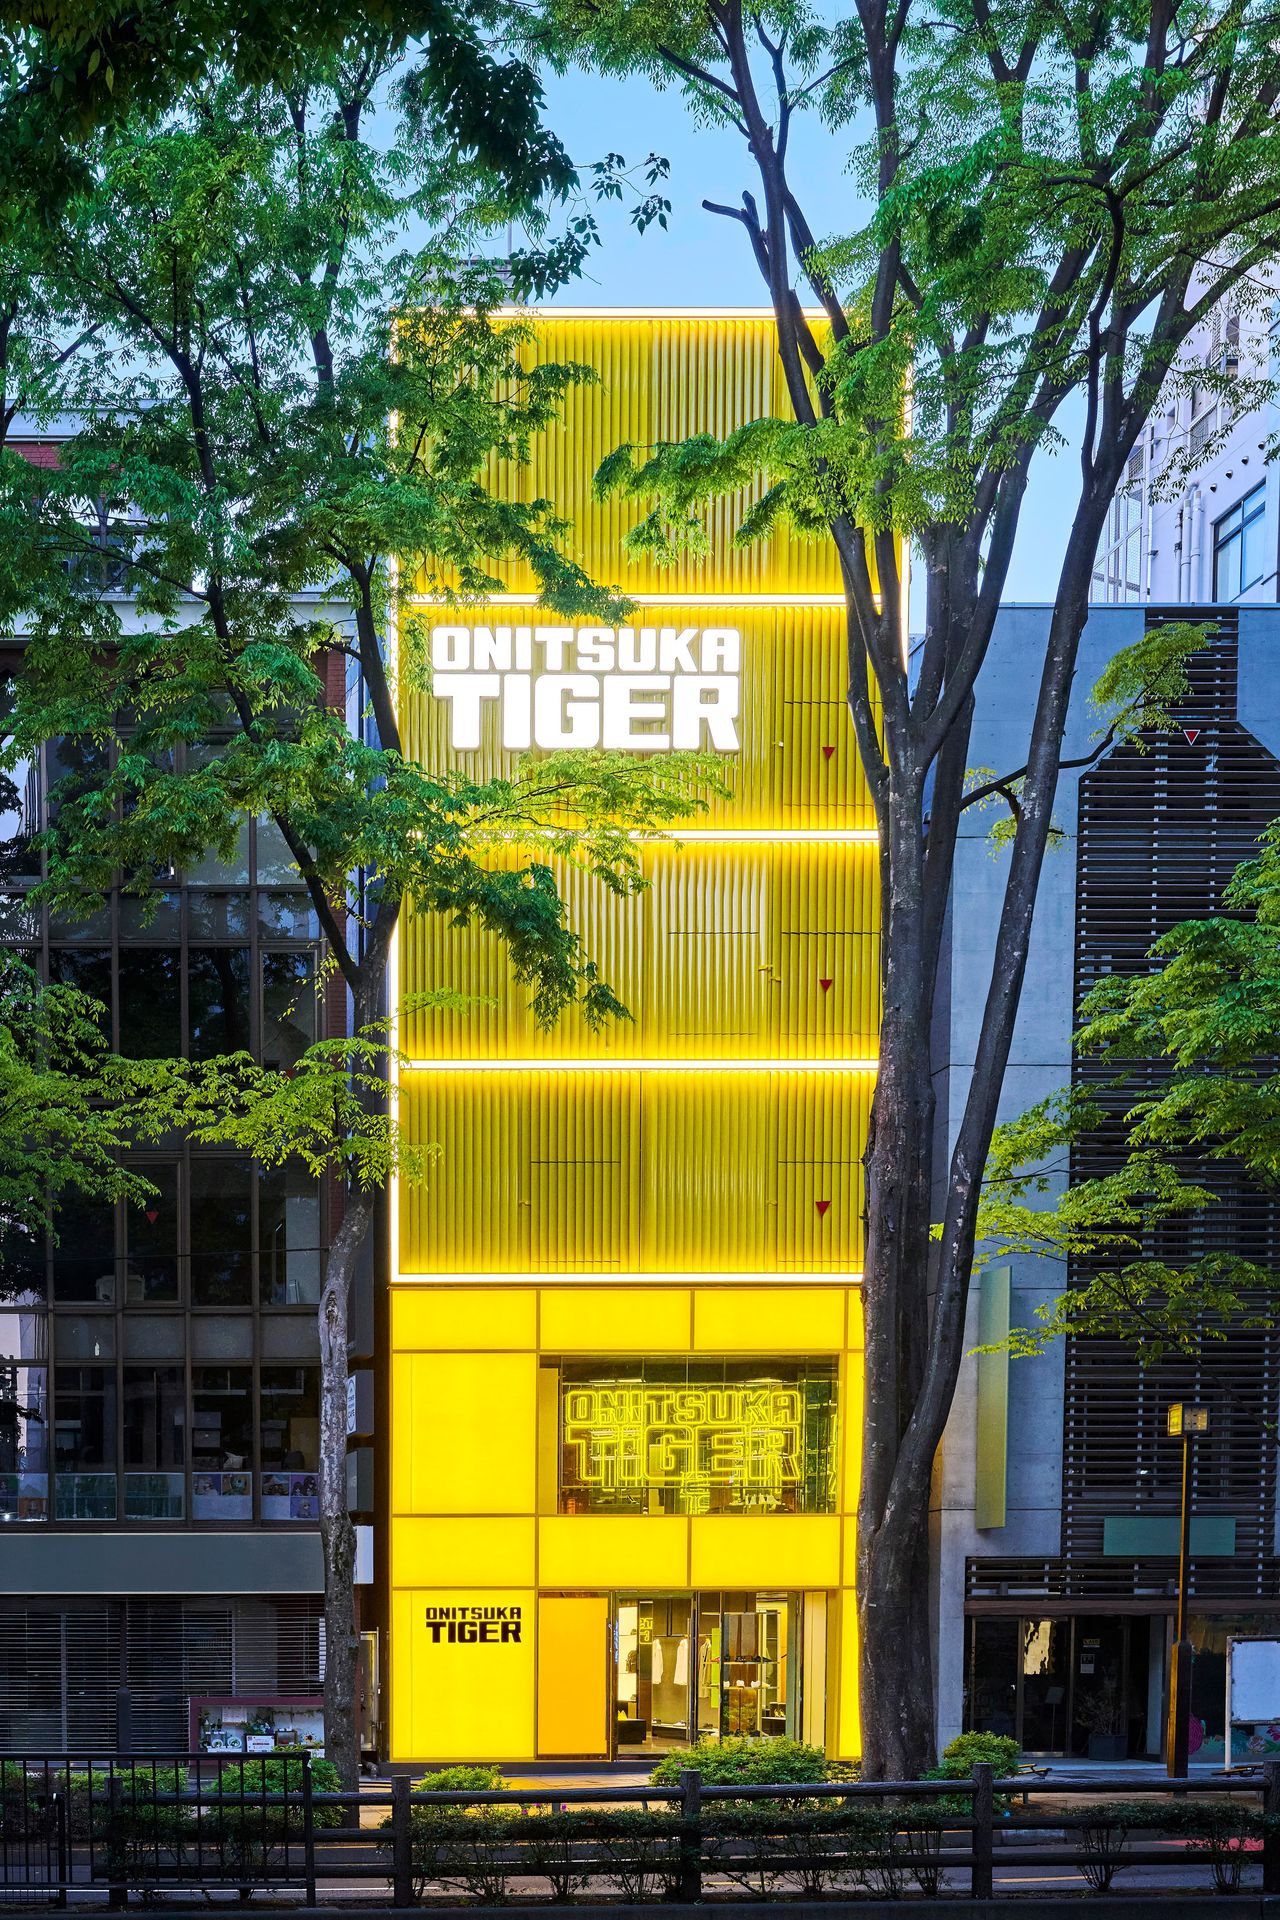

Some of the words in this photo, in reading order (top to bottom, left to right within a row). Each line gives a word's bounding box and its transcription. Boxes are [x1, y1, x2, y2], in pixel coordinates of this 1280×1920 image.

[431, 626, 740, 672] ONITSUKA
[431, 673, 740, 751] TIGER
[566, 1390, 801, 1424] ONITSUKA
[566, 1425, 801, 1480] TIGER
[426, 1607, 521, 1620] ONITSUKA
[426, 1621, 521, 1643] TIGER
